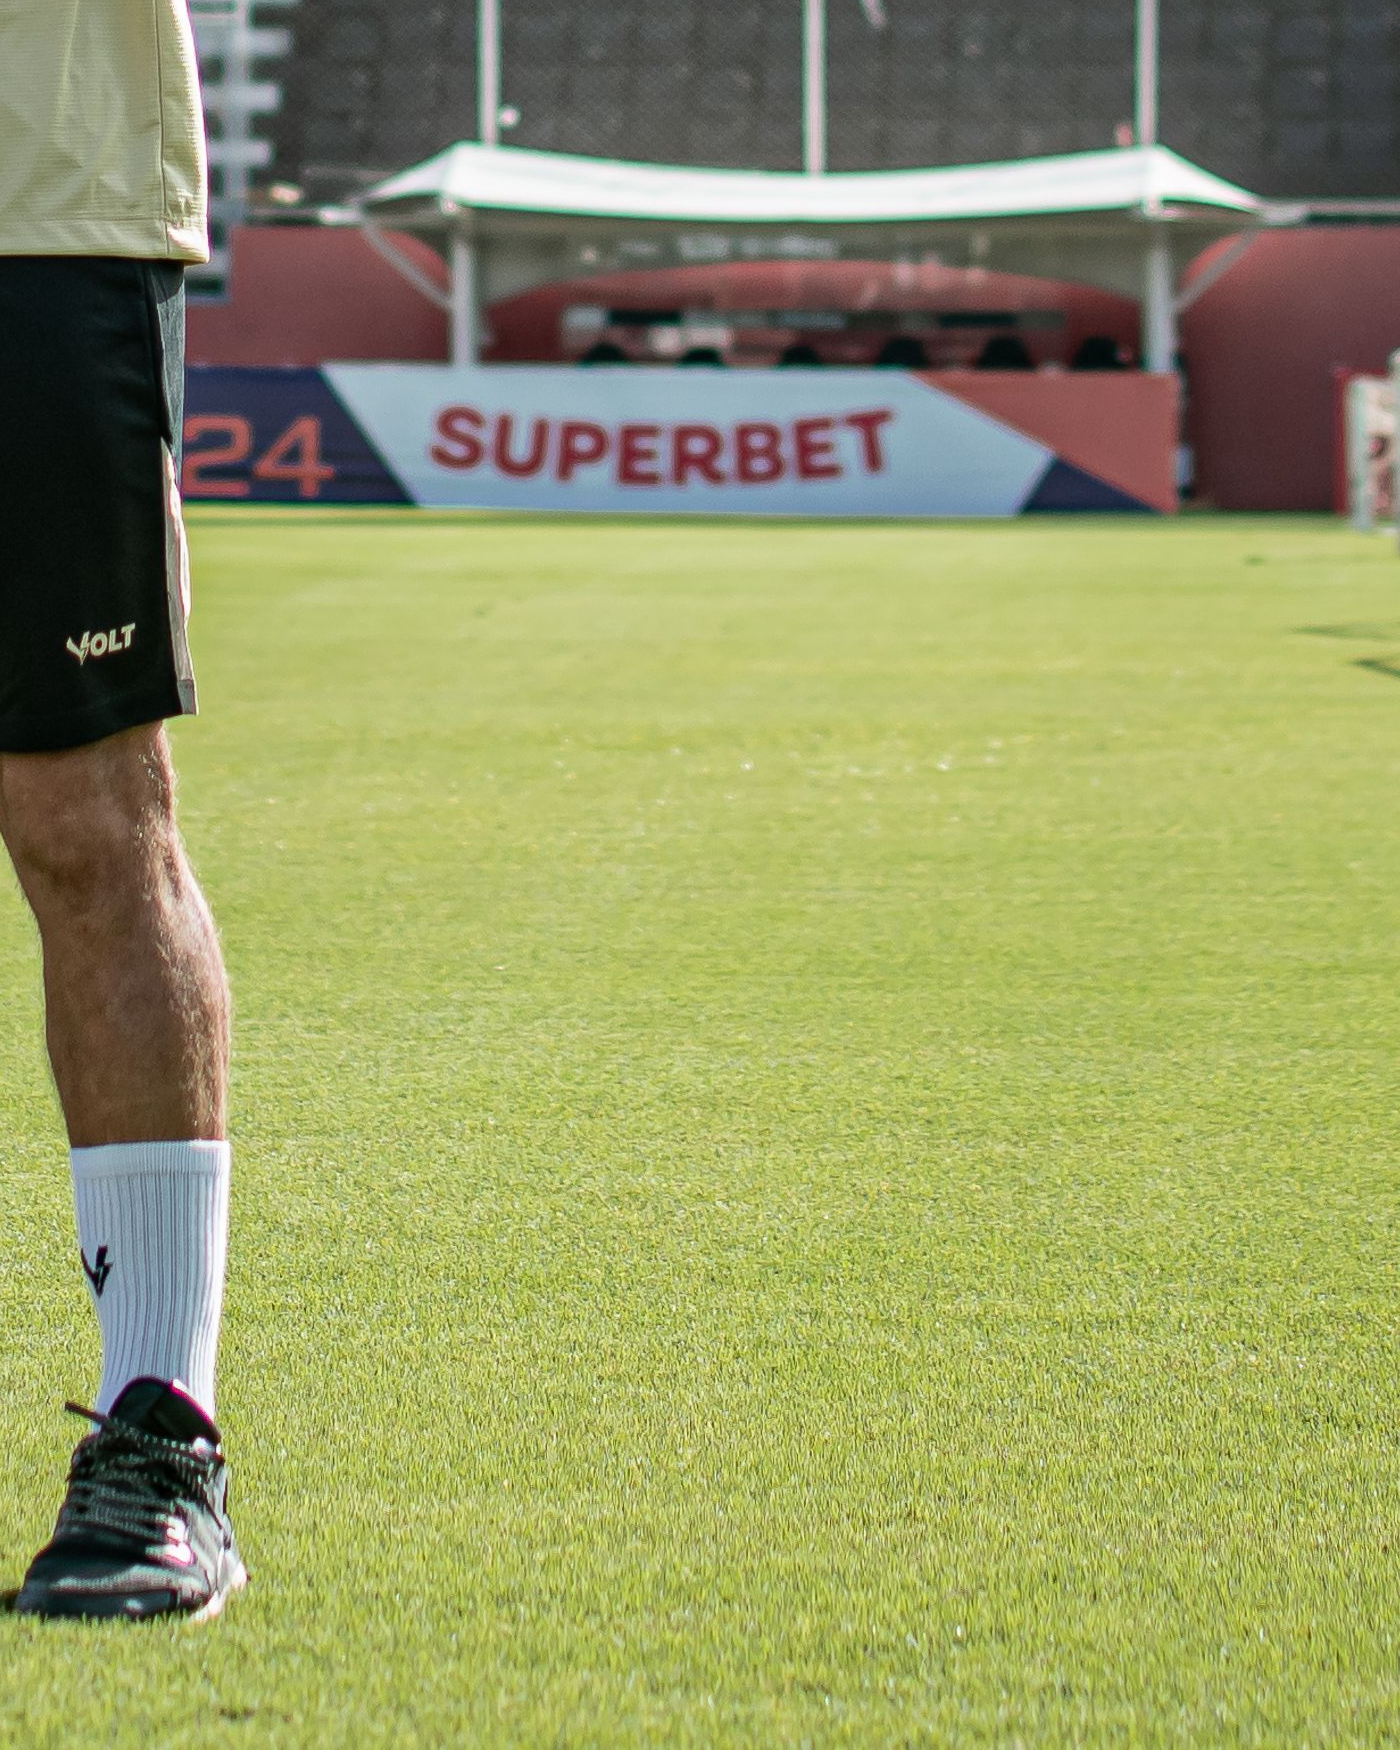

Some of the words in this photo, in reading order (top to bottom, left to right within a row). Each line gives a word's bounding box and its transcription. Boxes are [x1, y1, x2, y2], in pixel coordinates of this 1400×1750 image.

[182, 414, 335, 497] 24
[430, 406, 895, 487] SUPERBET
[66, 621, 136, 666] VOLT
